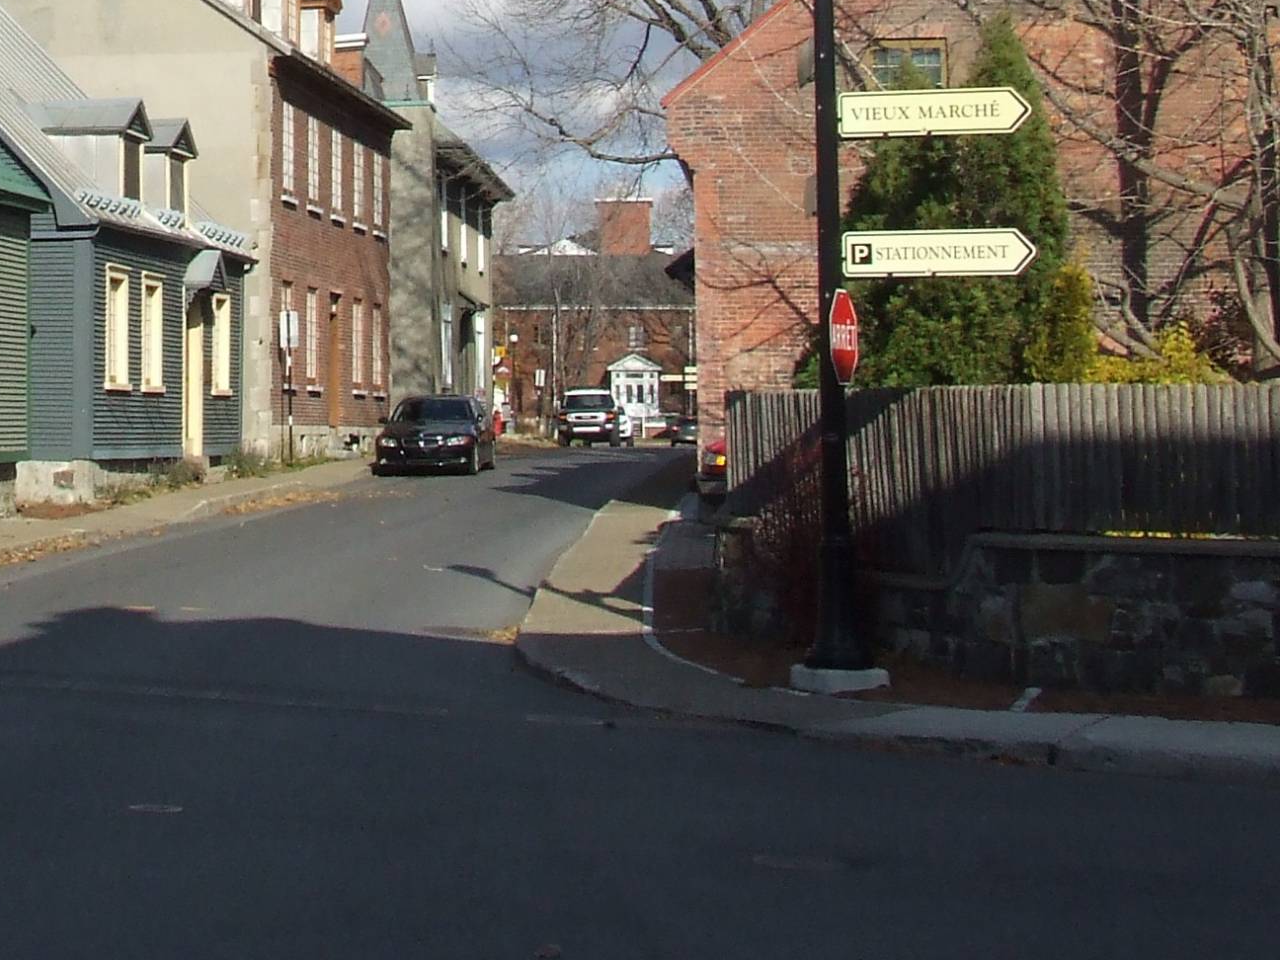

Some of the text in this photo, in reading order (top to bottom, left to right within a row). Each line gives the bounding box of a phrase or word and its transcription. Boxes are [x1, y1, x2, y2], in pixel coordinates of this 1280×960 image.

[851, 100, 1000, 121] VIEUX MARCHÉ
[853, 245, 1009, 264] P STATIONNEMENT
[831, 319, 856, 351] ARRÊT
